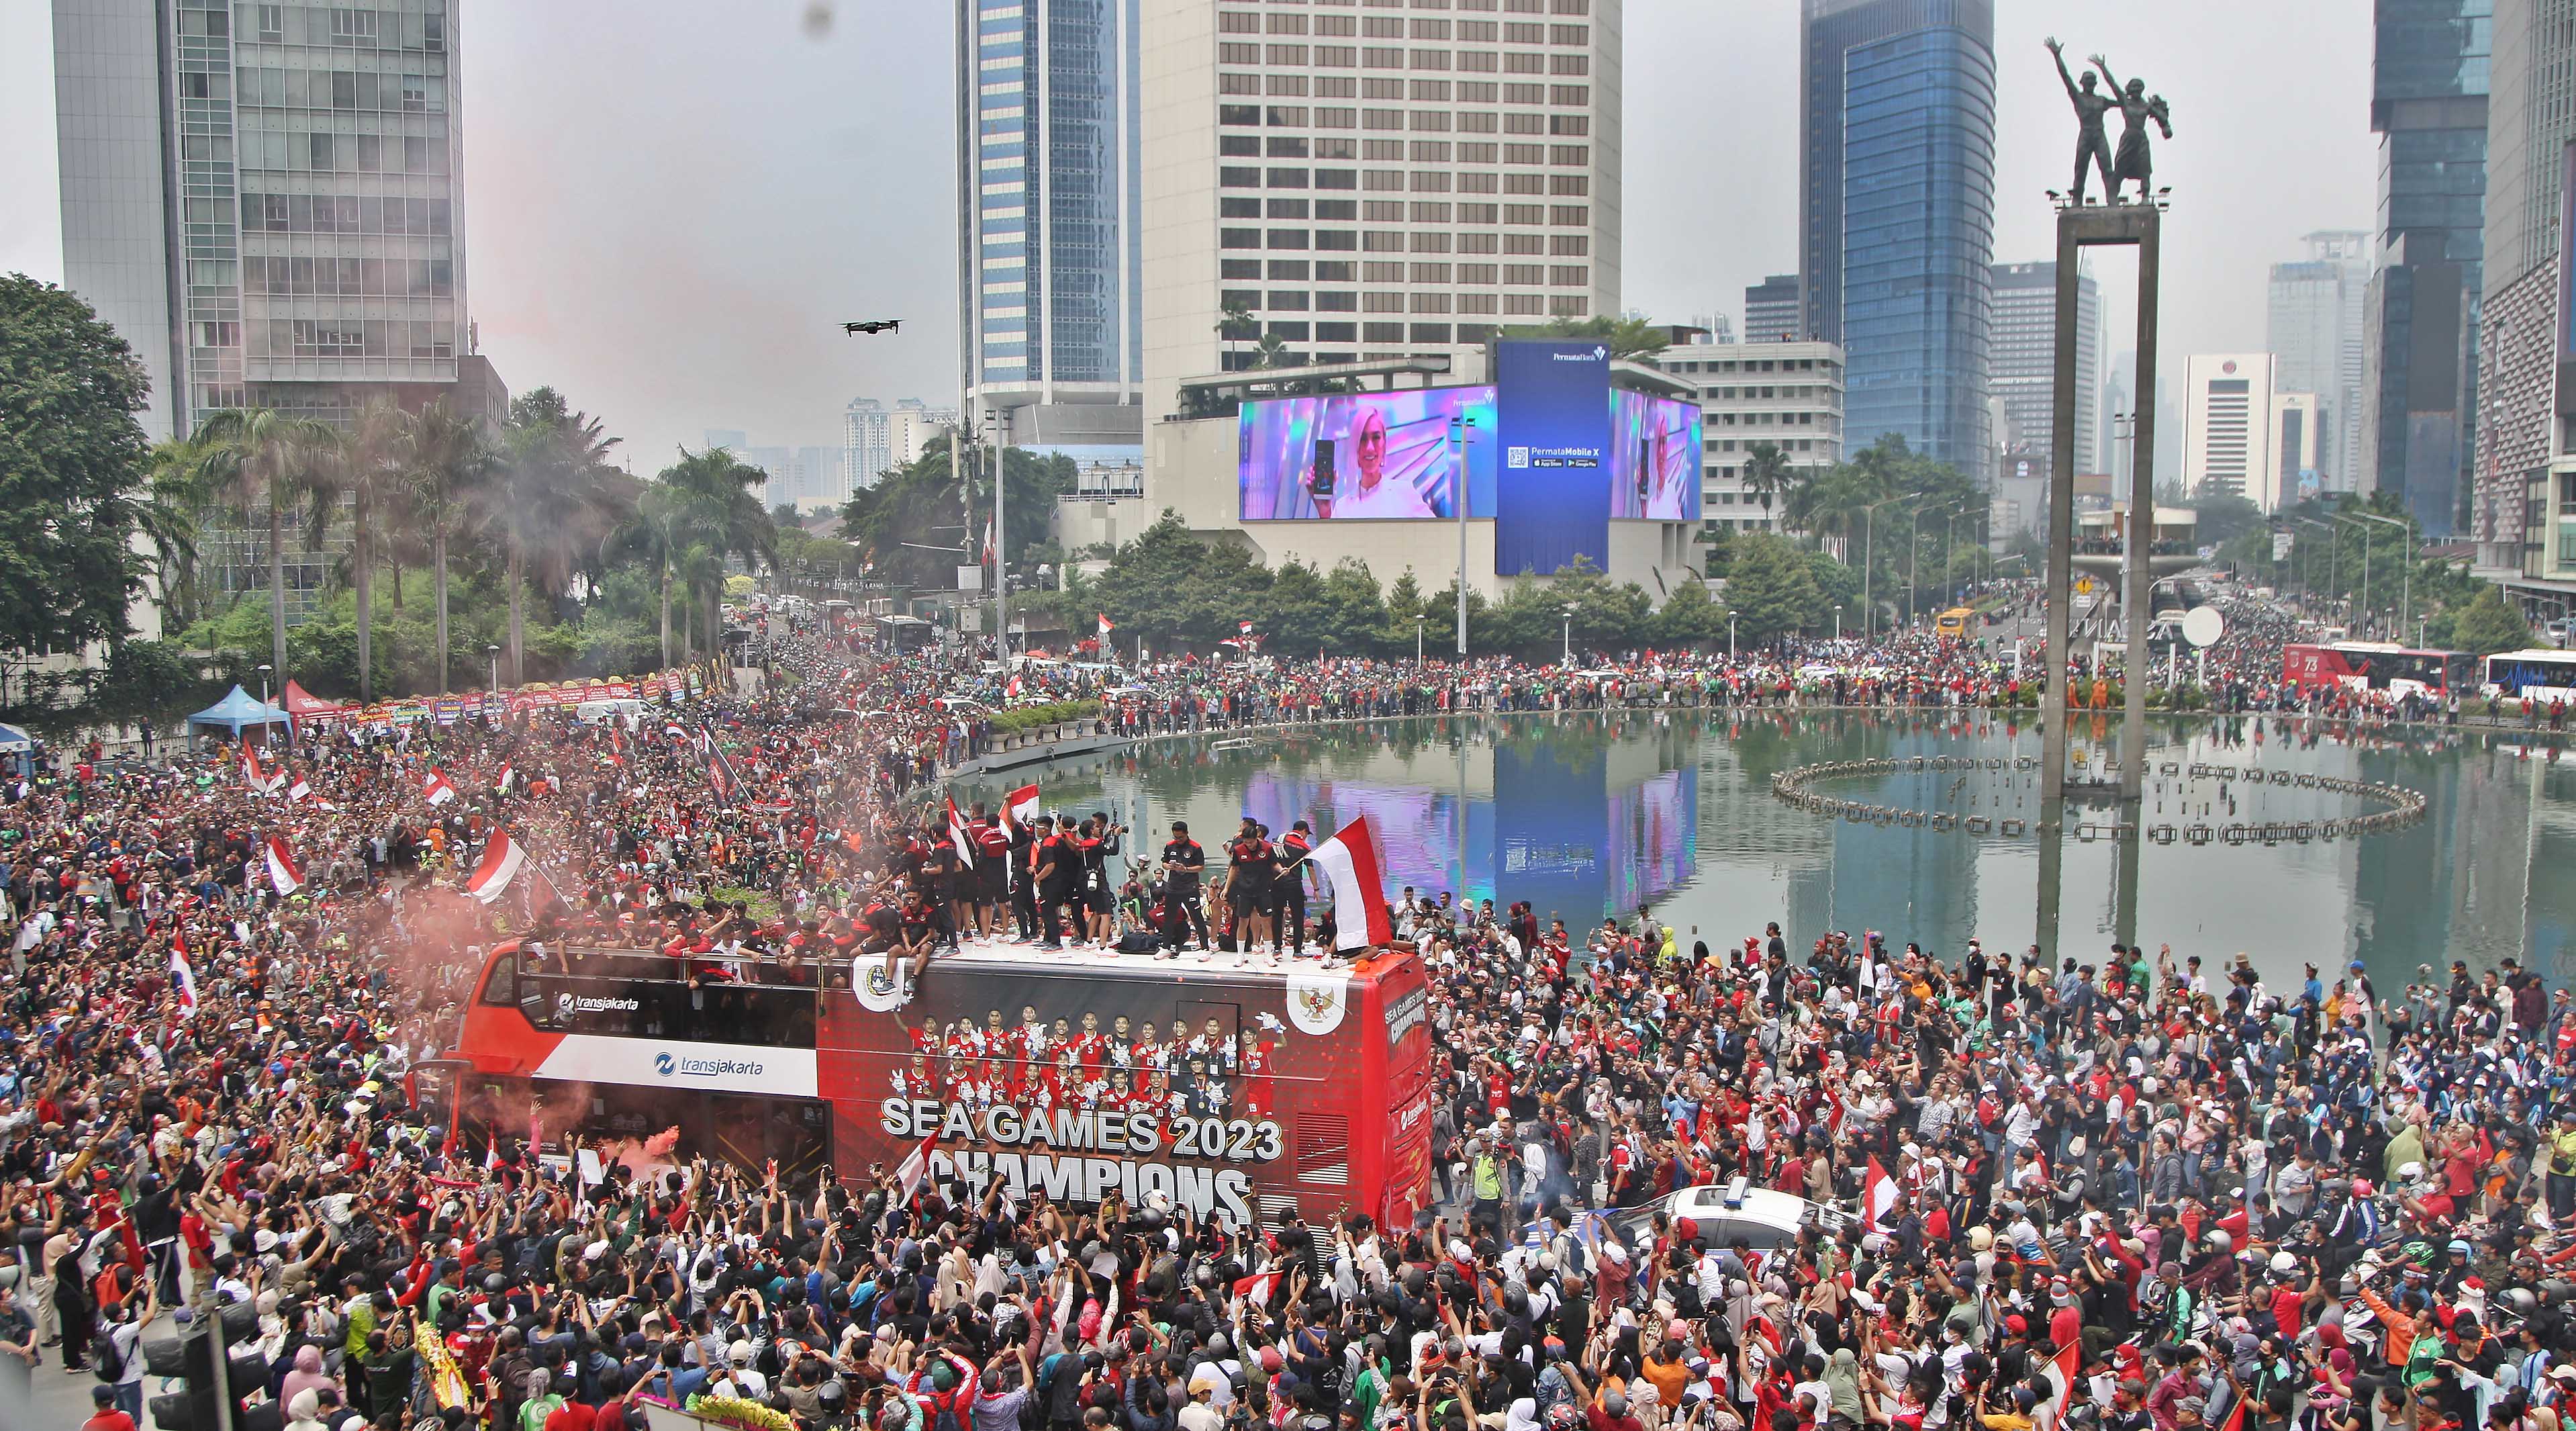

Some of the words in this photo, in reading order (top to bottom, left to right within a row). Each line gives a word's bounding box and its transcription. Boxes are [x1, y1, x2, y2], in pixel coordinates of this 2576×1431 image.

[1531, 447, 1592, 457] PermataMobile
[1593, 448, 1599, 456] X
[577, 995, 639, 1011] transjakarta
[1385, 1009, 1398, 1025] SEA
[1397, 995, 1416, 1016] GAMES
[1088, 1045, 1093, 1054] 5
[681, 1056, 763, 1076] transjakarta
[1147, 1057, 1154, 1066] 13
[917, 1085, 922, 1093] 2
[1029, 1097, 1035, 1106] 3
[1249, 1103, 1257, 1112] 19
[1155, 1108, 1163, 1117] 10
[881, 1097, 976, 1140] SEA
[986, 1105, 1160, 1152] GAMES
[1173, 1116, 1283, 1160] 2023
